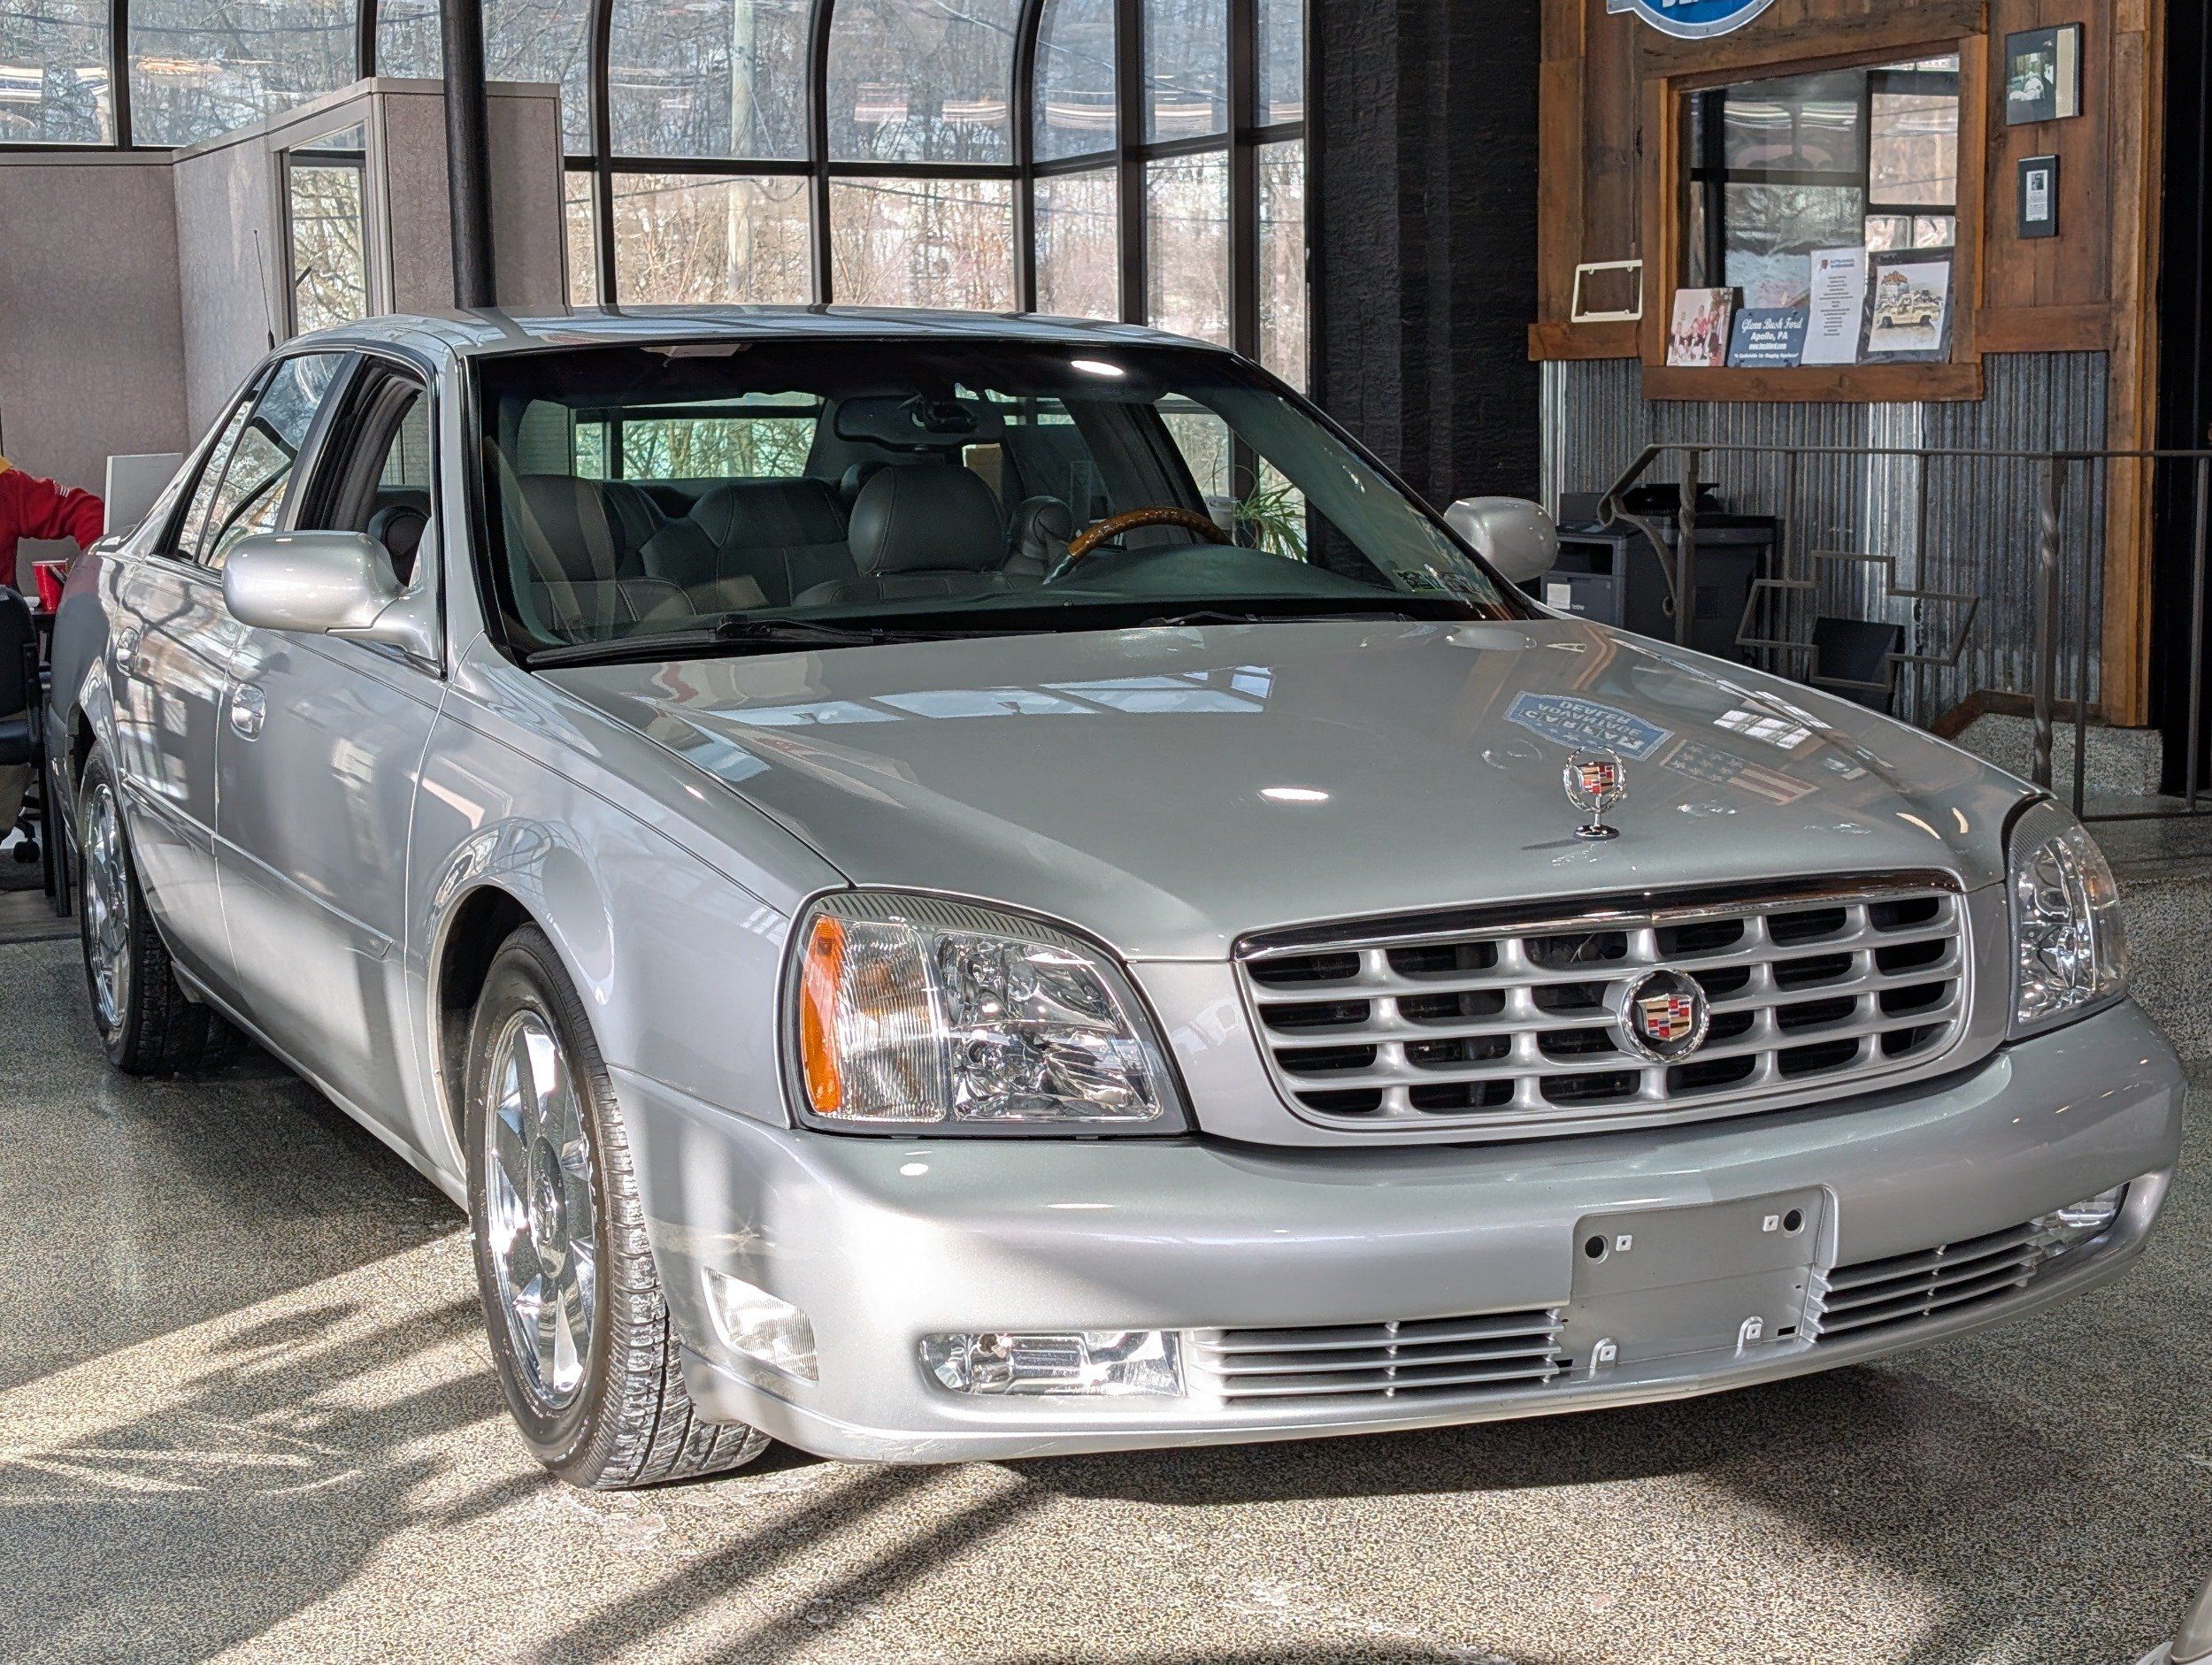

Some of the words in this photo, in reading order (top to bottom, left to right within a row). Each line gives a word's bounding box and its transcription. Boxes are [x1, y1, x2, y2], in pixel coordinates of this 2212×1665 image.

[1763, 318, 1783, 330] Bush
[1784, 317, 1803, 329] Ford
[1750, 331, 1776, 341] Apollo,
[1777, 331, 1788, 340] PA
